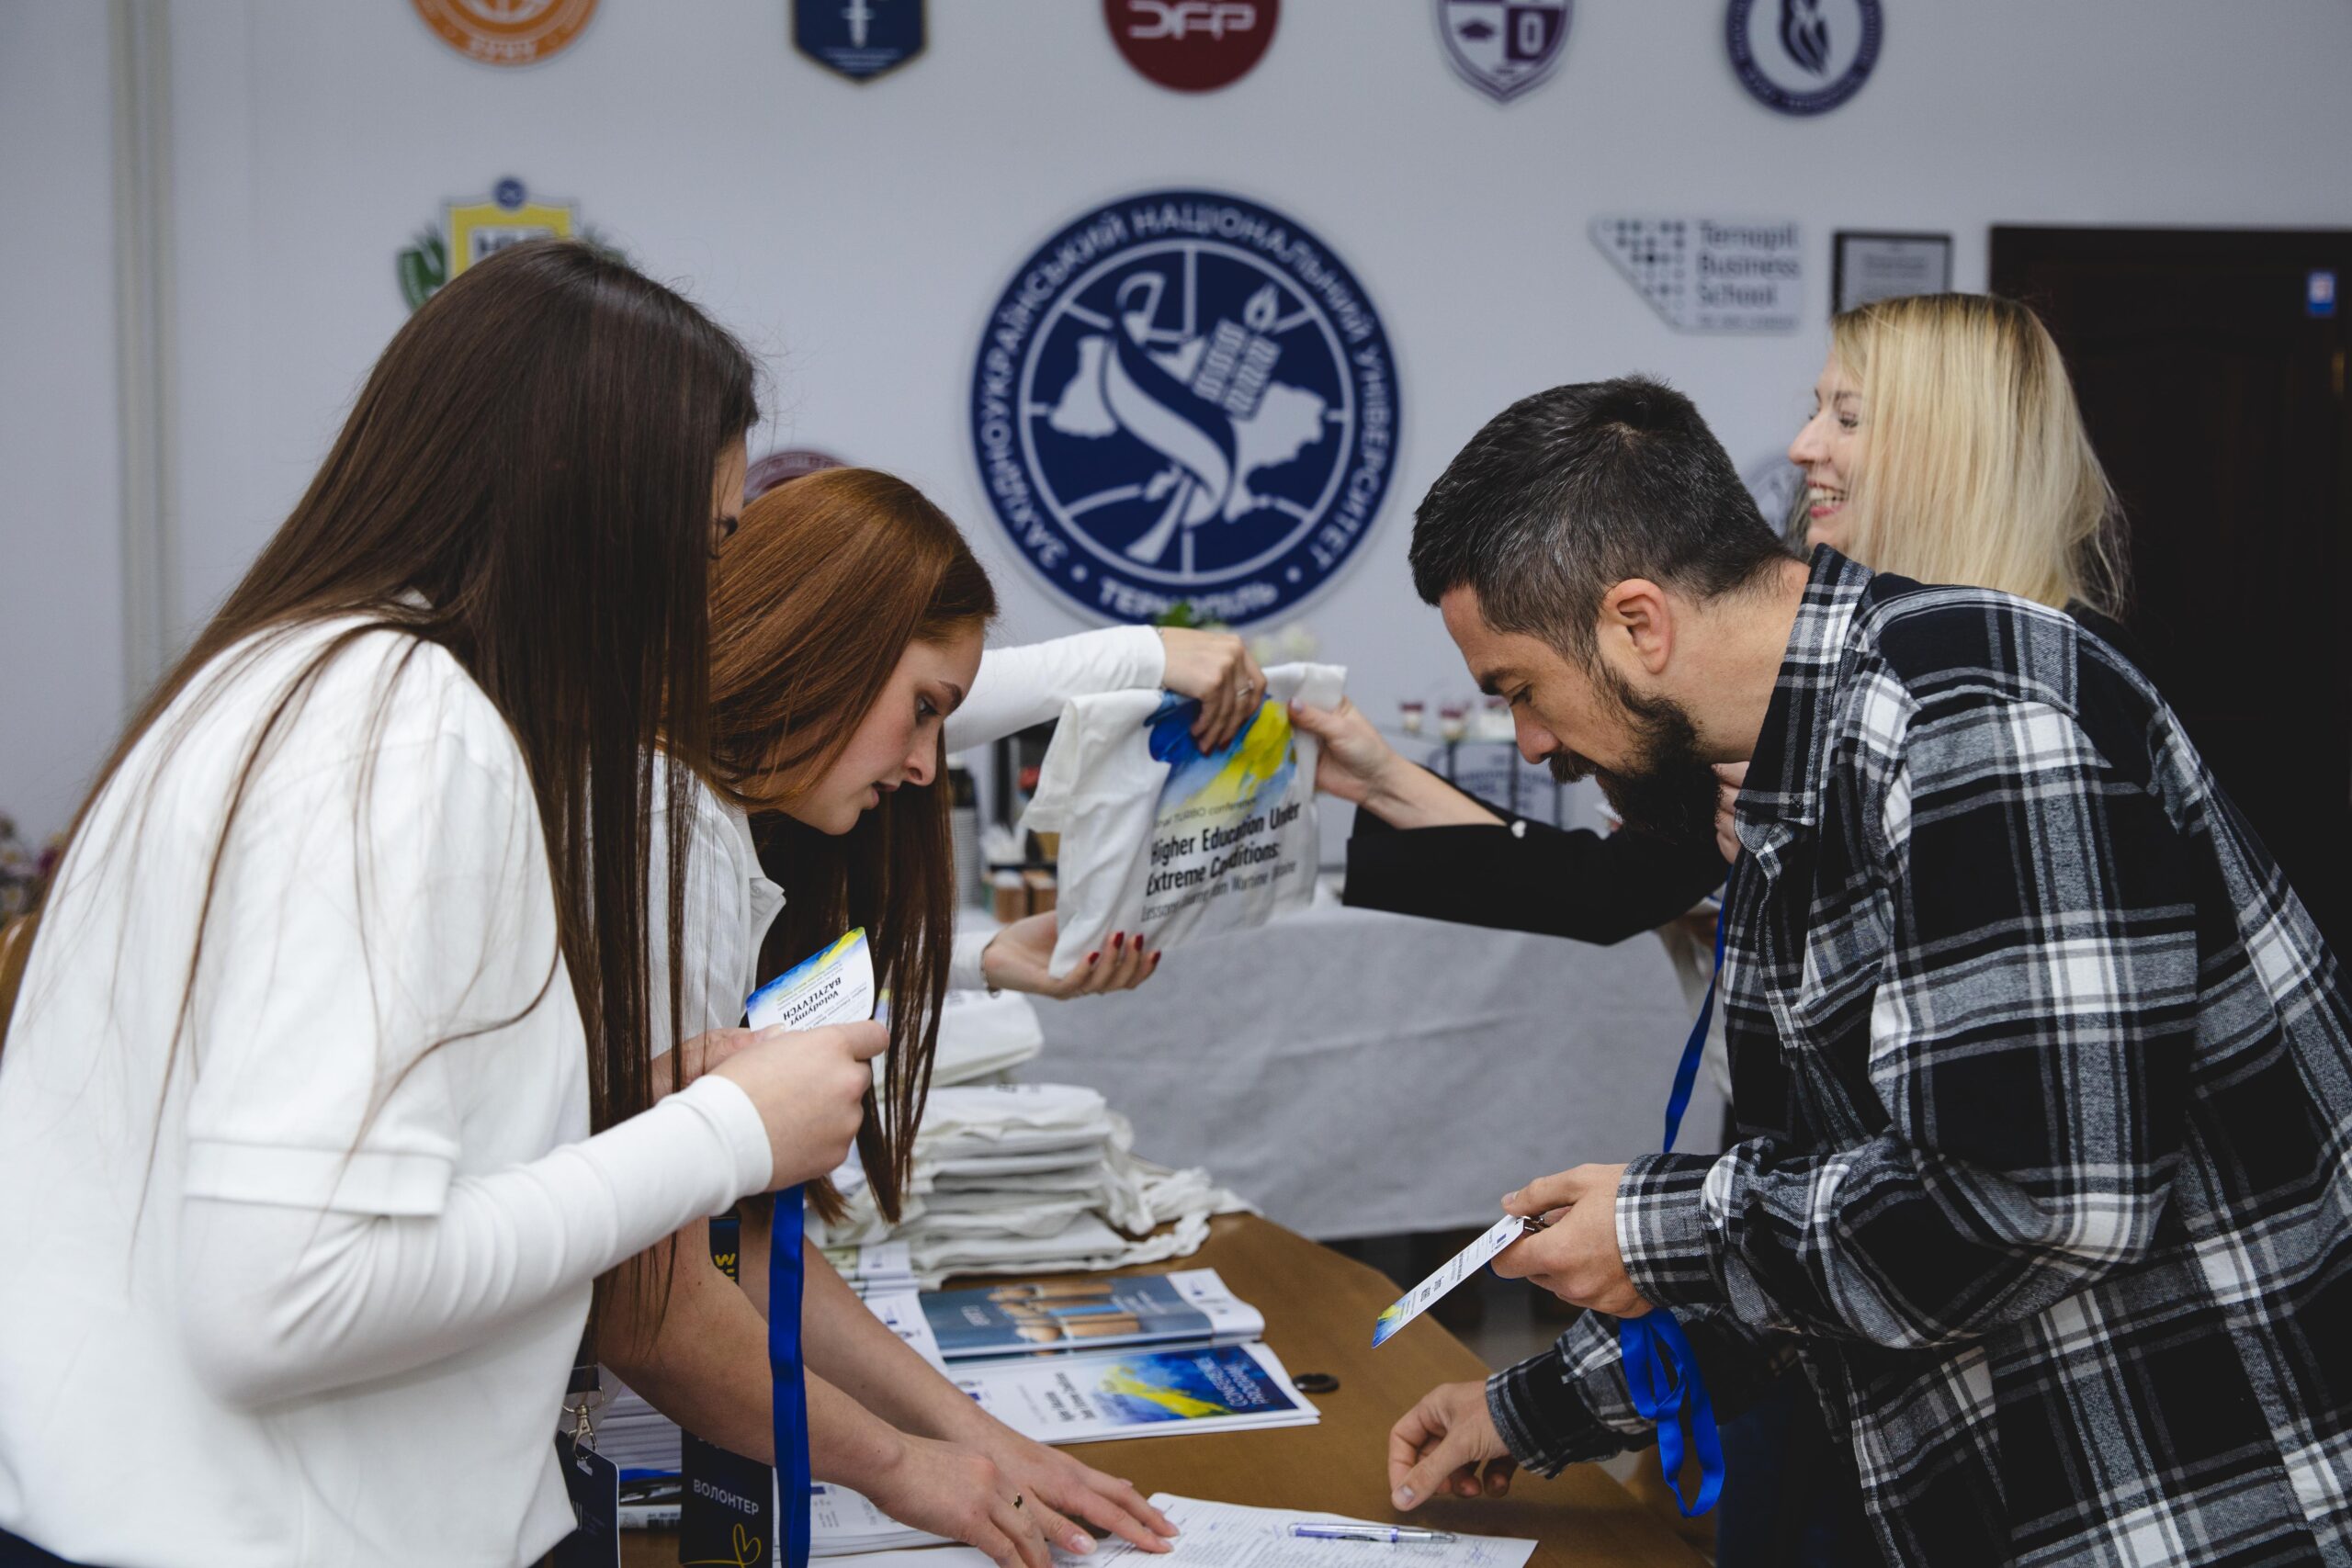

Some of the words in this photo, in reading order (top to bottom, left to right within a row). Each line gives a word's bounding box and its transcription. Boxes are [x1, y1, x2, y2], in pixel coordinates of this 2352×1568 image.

[1698, 253, 1803, 279] Business
[1698, 283, 1778, 308] School
[1131, 202, 1376, 344] НАЦІОНАЛЬНИЙ
[1308, 343, 1392, 571] УНІВЕРСИТЕТ
[1202, 814, 1264, 852] Education
[1146, 866, 1206, 897] Extreme
[783, 976, 842, 1021] BAZYLEVYCH
[790, 990, 839, 1026] Volodymyr
[694, 1478, 760, 1516] ВОЛОНТЕР
